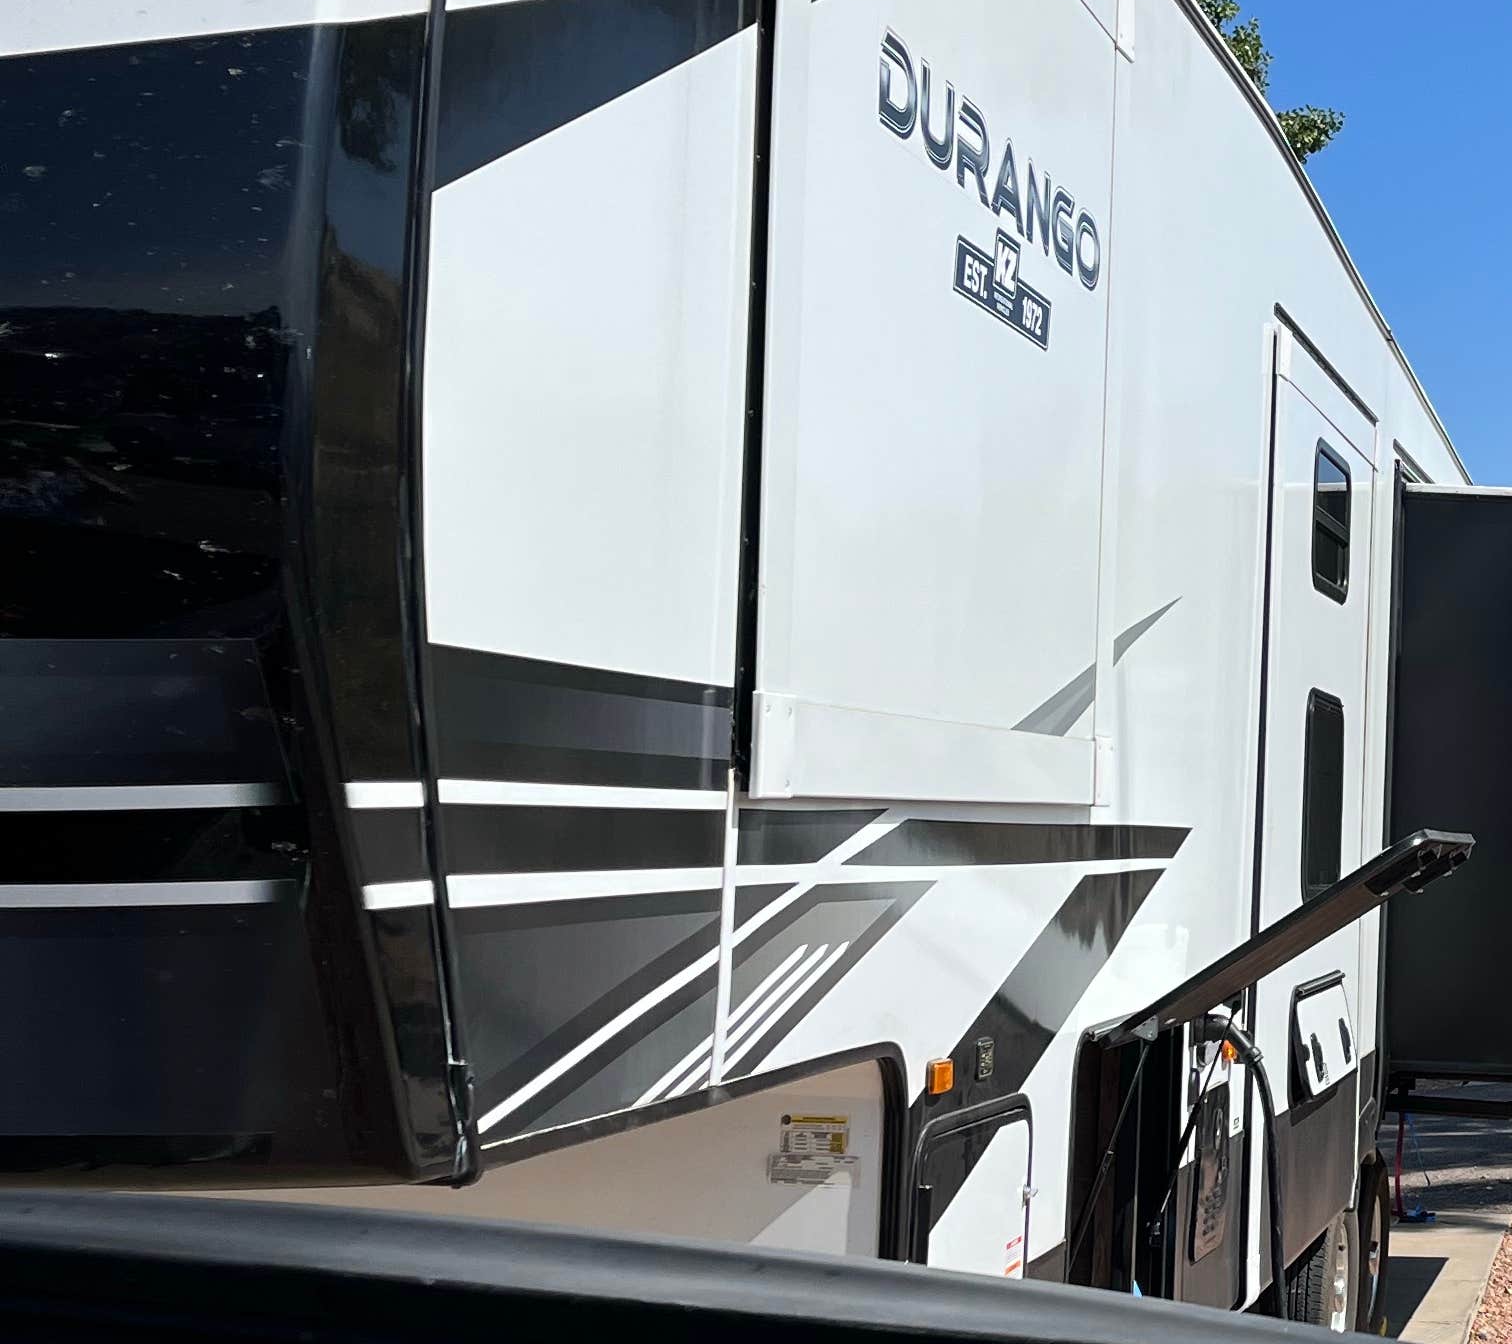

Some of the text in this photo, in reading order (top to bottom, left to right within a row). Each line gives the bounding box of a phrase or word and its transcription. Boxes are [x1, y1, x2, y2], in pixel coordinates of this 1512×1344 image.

[878, 25, 1101, 292] DURANGO
[963, 253, 988, 299] EST.
[995, 240, 1018, 293] KZ
[1022, 296, 1043, 336] 1972
